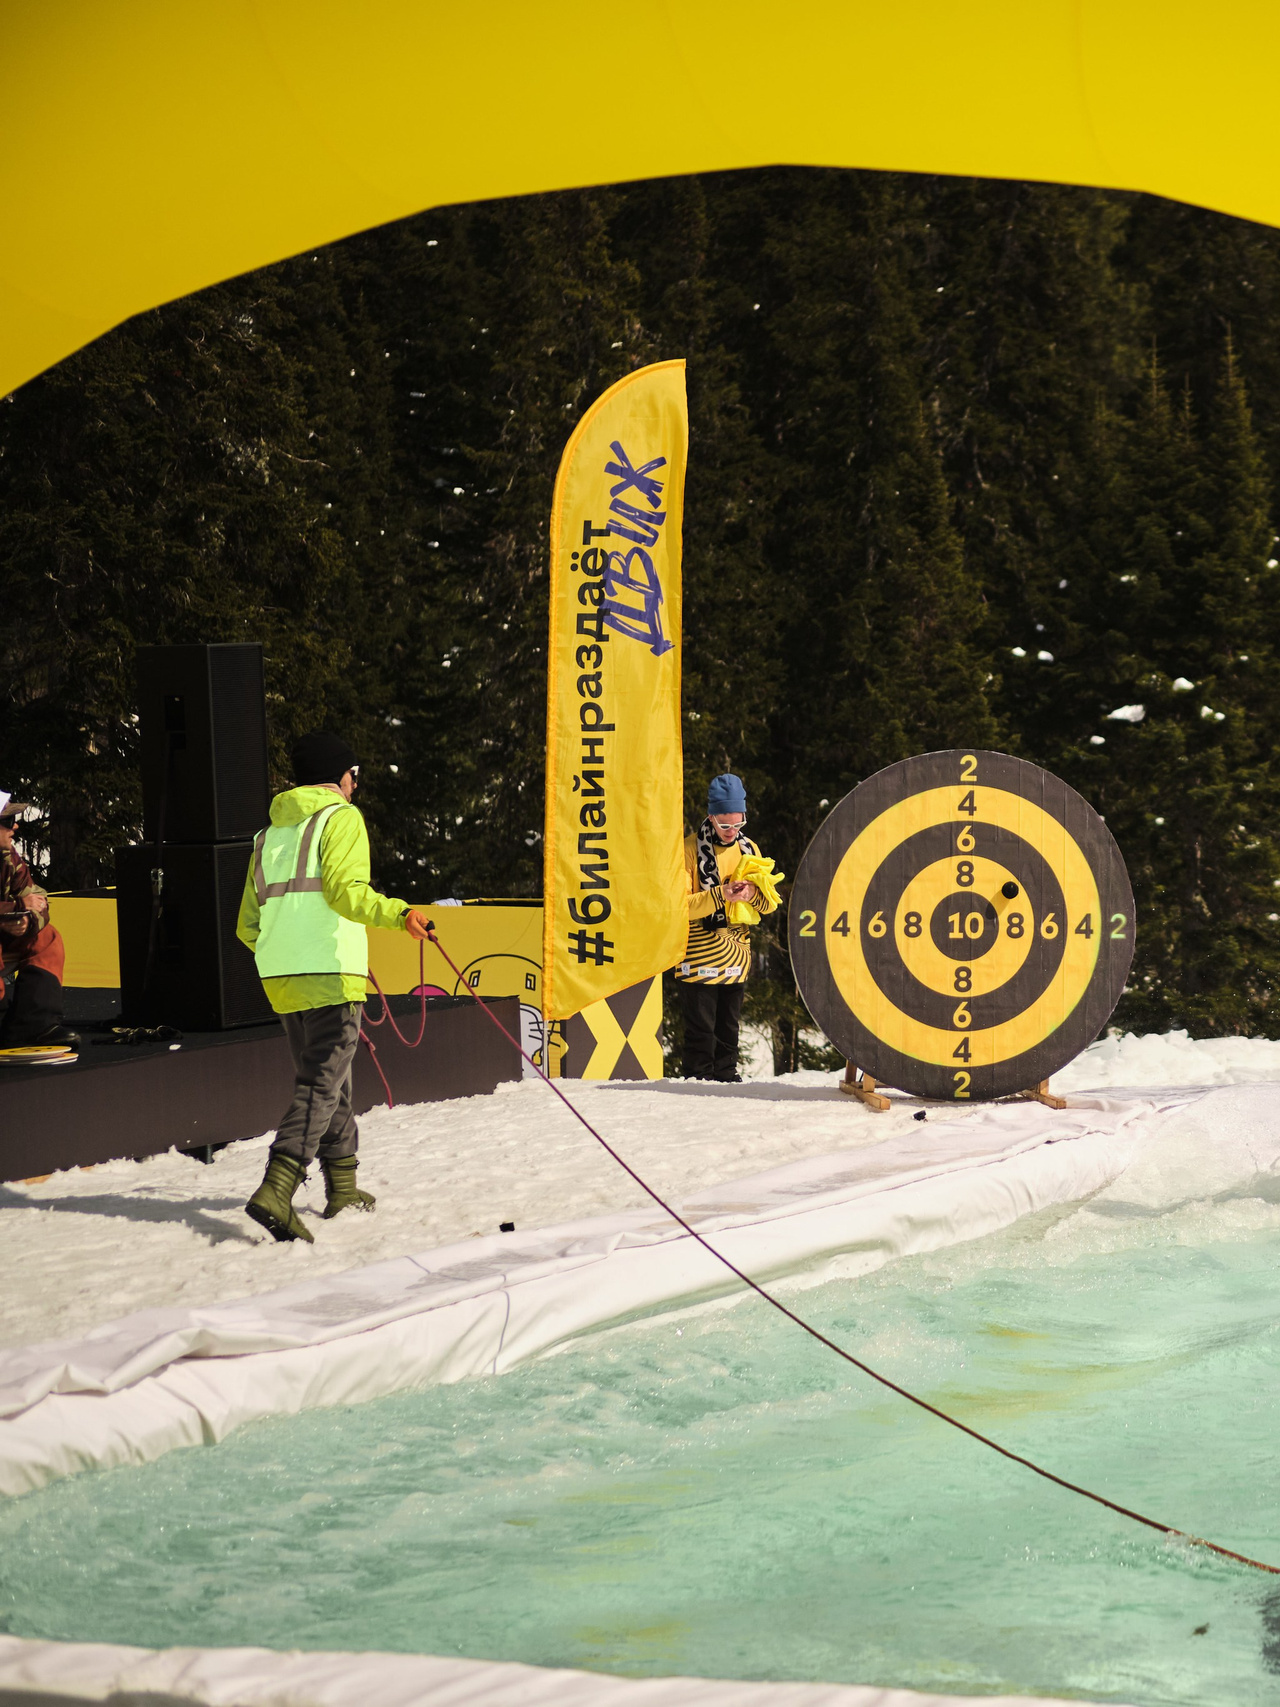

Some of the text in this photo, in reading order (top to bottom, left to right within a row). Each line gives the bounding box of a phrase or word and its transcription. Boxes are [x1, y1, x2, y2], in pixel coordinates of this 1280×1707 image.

[567, 520, 615, 966] #билайнраздаёт
[959, 755, 978, 782] 2
[958, 790, 977, 816] 4
[957, 826, 976, 852] 6
[956, 861, 975, 887] 8
[799, 910, 1126, 939] 2 4 6 8 10 8 6 4 2
[954, 966, 972, 992] 8
[952, 1002, 972, 1028] 6
[952, 1037, 972, 1062] 4
[953, 1071, 971, 1097] 2
